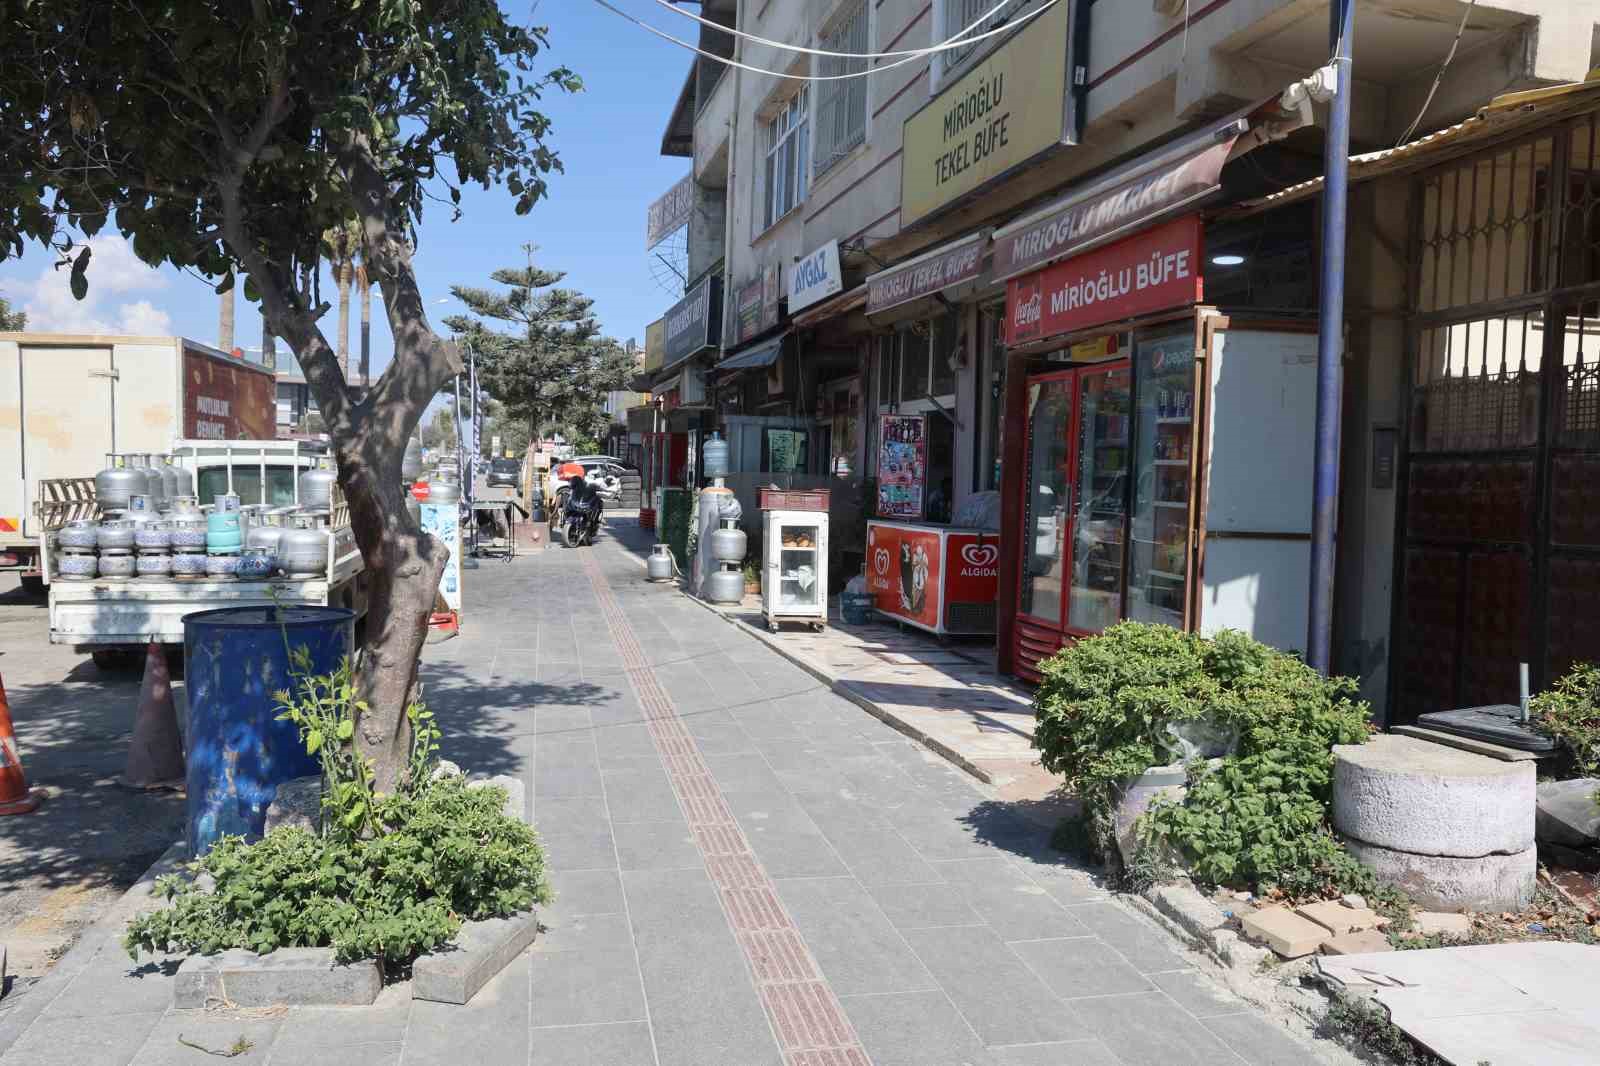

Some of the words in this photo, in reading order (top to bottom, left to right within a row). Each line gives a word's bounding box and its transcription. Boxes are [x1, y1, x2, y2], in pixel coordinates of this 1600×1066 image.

[943, 72, 1003, 143] MİRİOĞLU
[935, 140, 970, 187] TEKEL
[974, 112, 1010, 165] BÜFE
[794, 250, 828, 295] AYGAZ
[1051, 268, 1131, 314] MİRİOĞLU
[1136, 250, 1191, 290] BÜFE
[960, 567, 997, 577] ALGIDA
